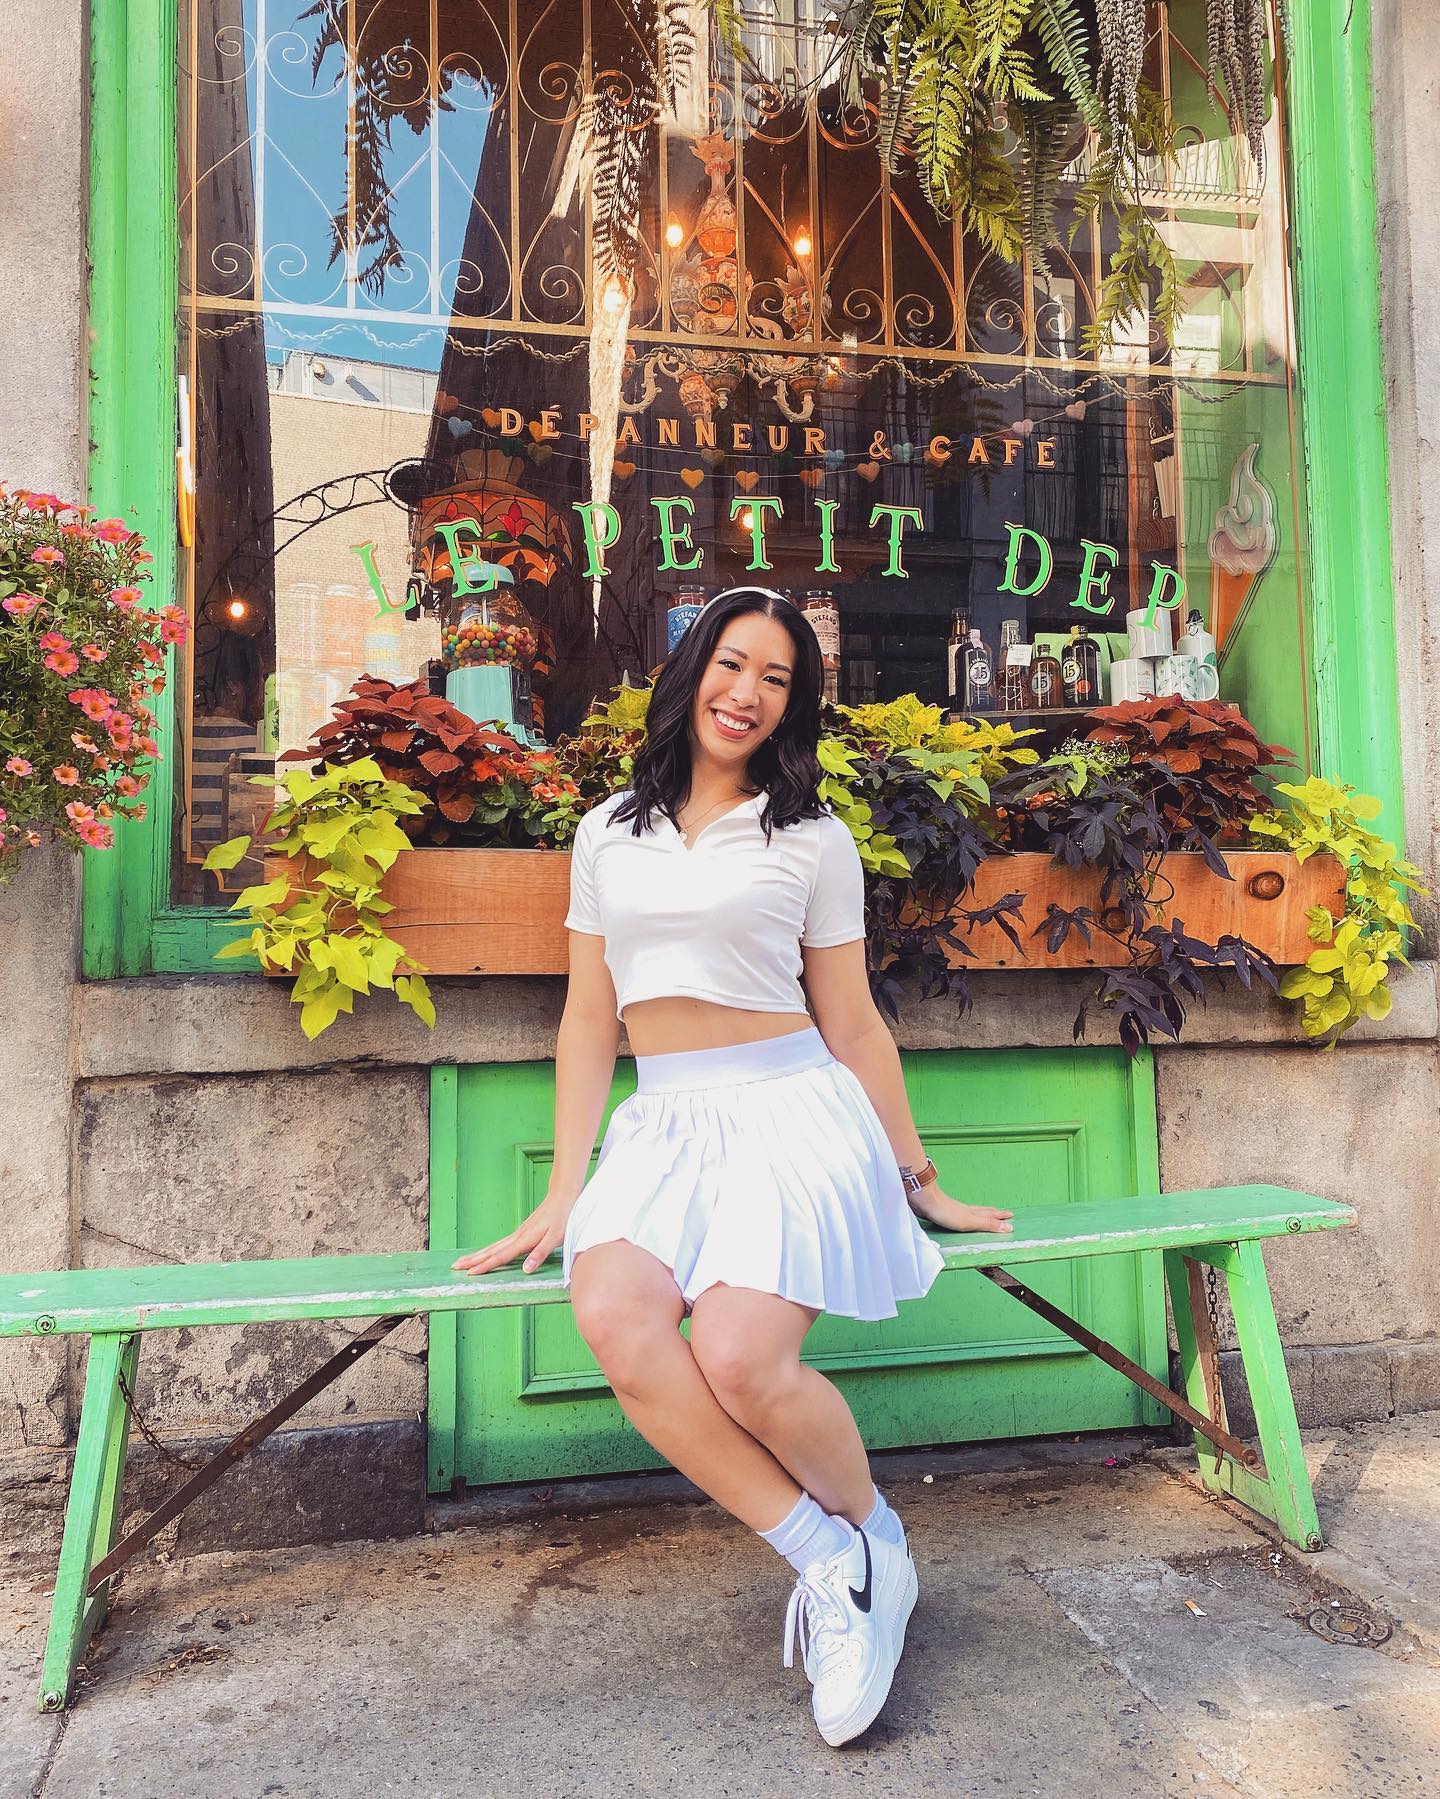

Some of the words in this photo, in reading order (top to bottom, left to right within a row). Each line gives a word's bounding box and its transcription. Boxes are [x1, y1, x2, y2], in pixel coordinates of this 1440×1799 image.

[500, 405, 827, 456] DÉPANNEUR
[869, 430, 892, 460] &
[930, 436, 1057, 469] CAFÉ
[350, 517, 499, 619] LE
[572, 496, 925, 579] PETIT
[997, 521, 1187, 632] DEP
[674, 611, 698, 623] STEFAN
